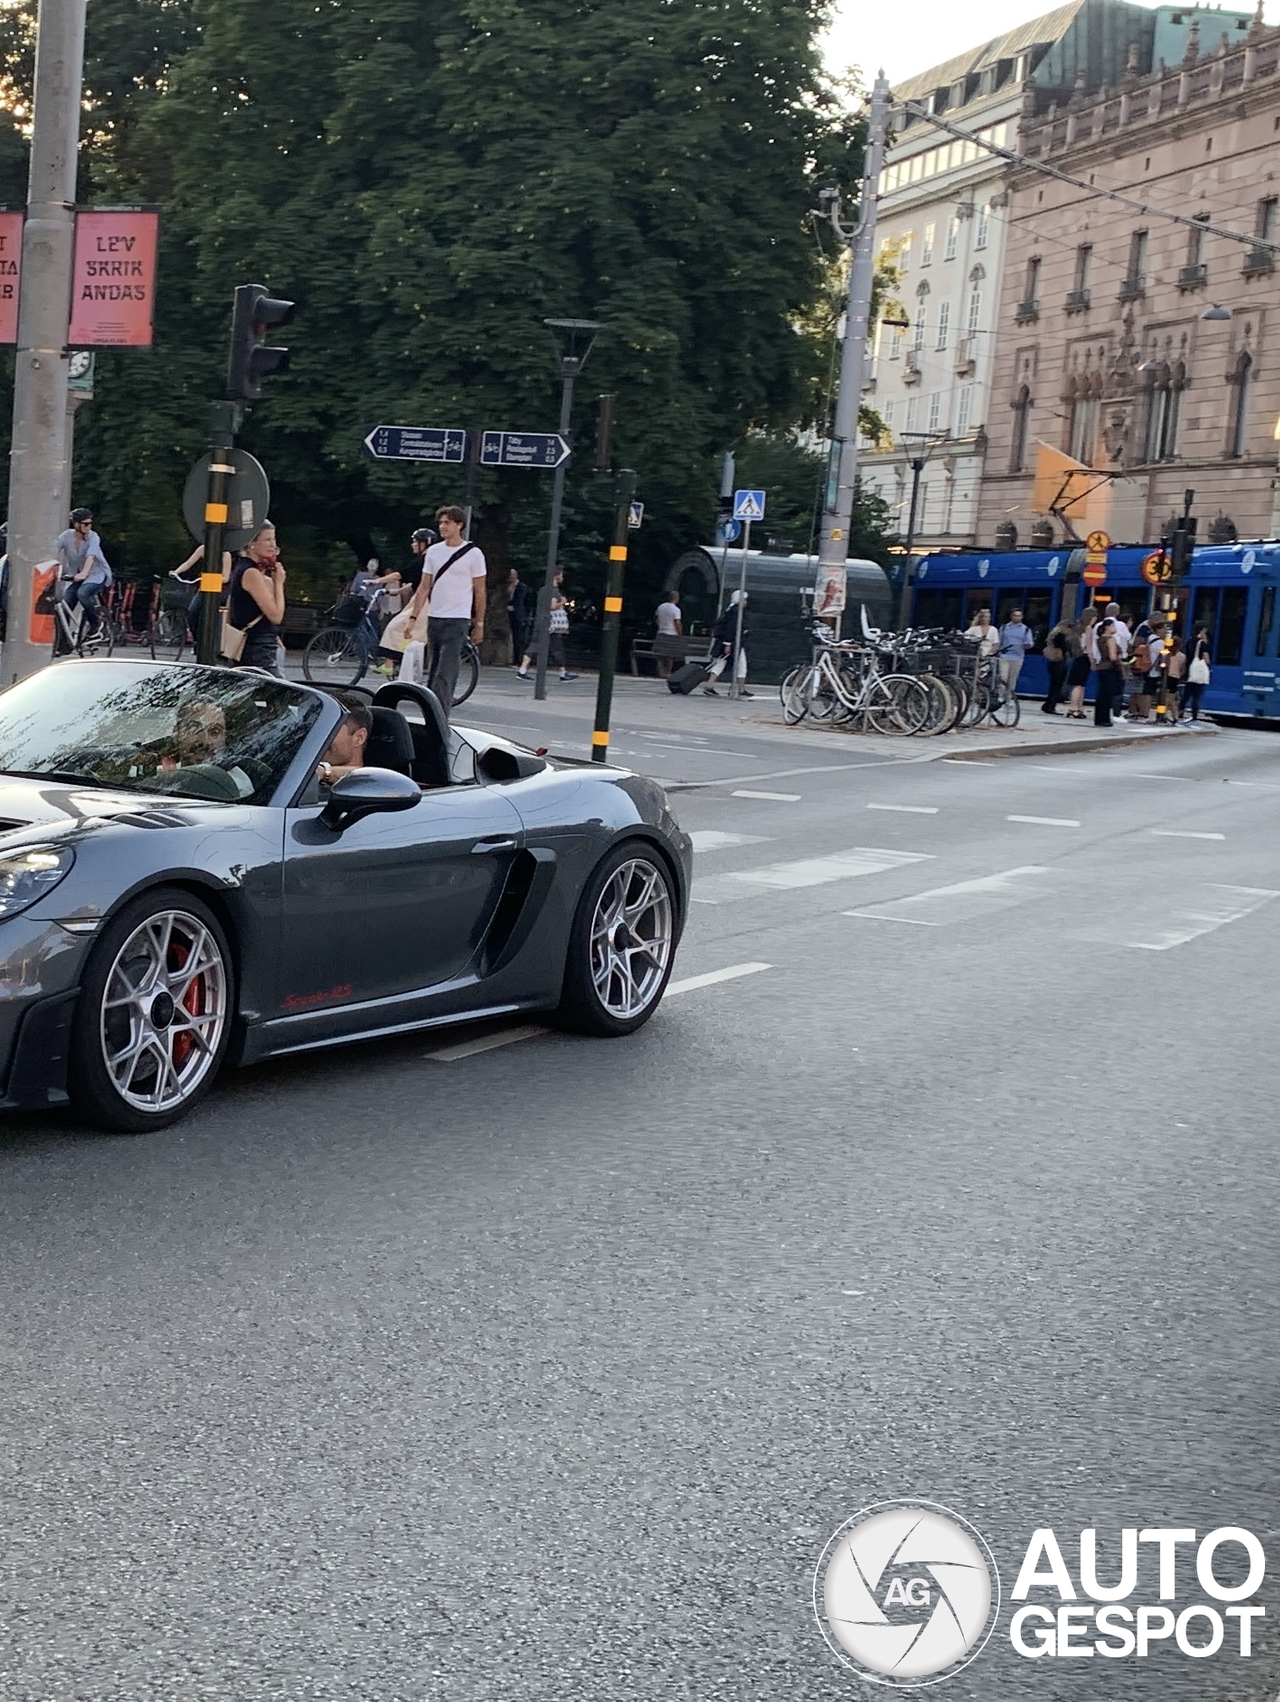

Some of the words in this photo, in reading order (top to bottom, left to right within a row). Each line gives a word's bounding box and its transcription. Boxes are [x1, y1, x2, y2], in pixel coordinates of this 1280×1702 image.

[96, 236, 136, 252] LEV
[85, 260, 143, 277] SKRIK
[81, 284, 146, 301] ANDAS
